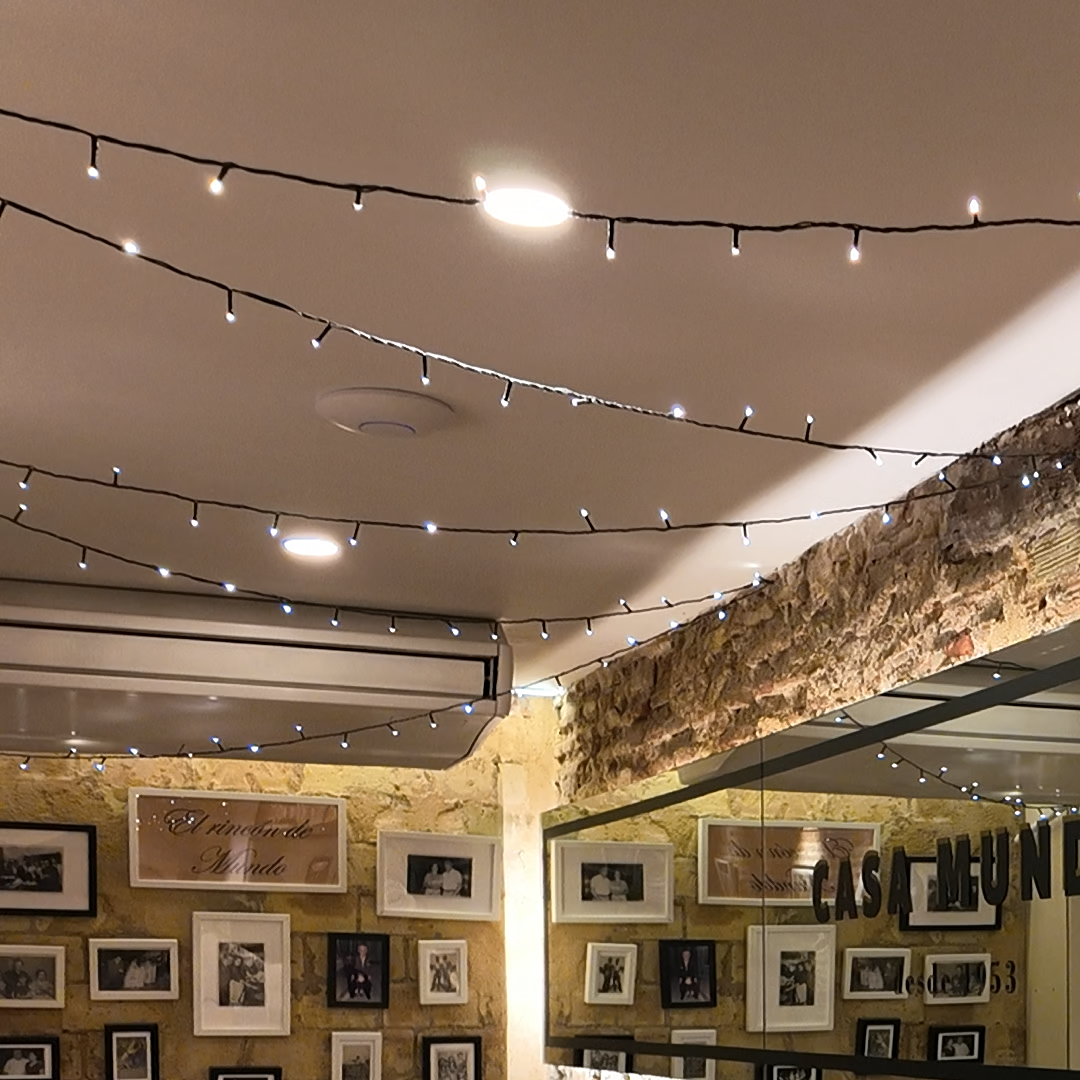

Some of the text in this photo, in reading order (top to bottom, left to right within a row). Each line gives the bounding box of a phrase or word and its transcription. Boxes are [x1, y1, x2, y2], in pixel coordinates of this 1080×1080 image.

[163, 808, 210, 837] El
[283, 818, 314, 840] de
[191, 845, 288, 877] Mundo
[812, 846, 913, 923] CASA
